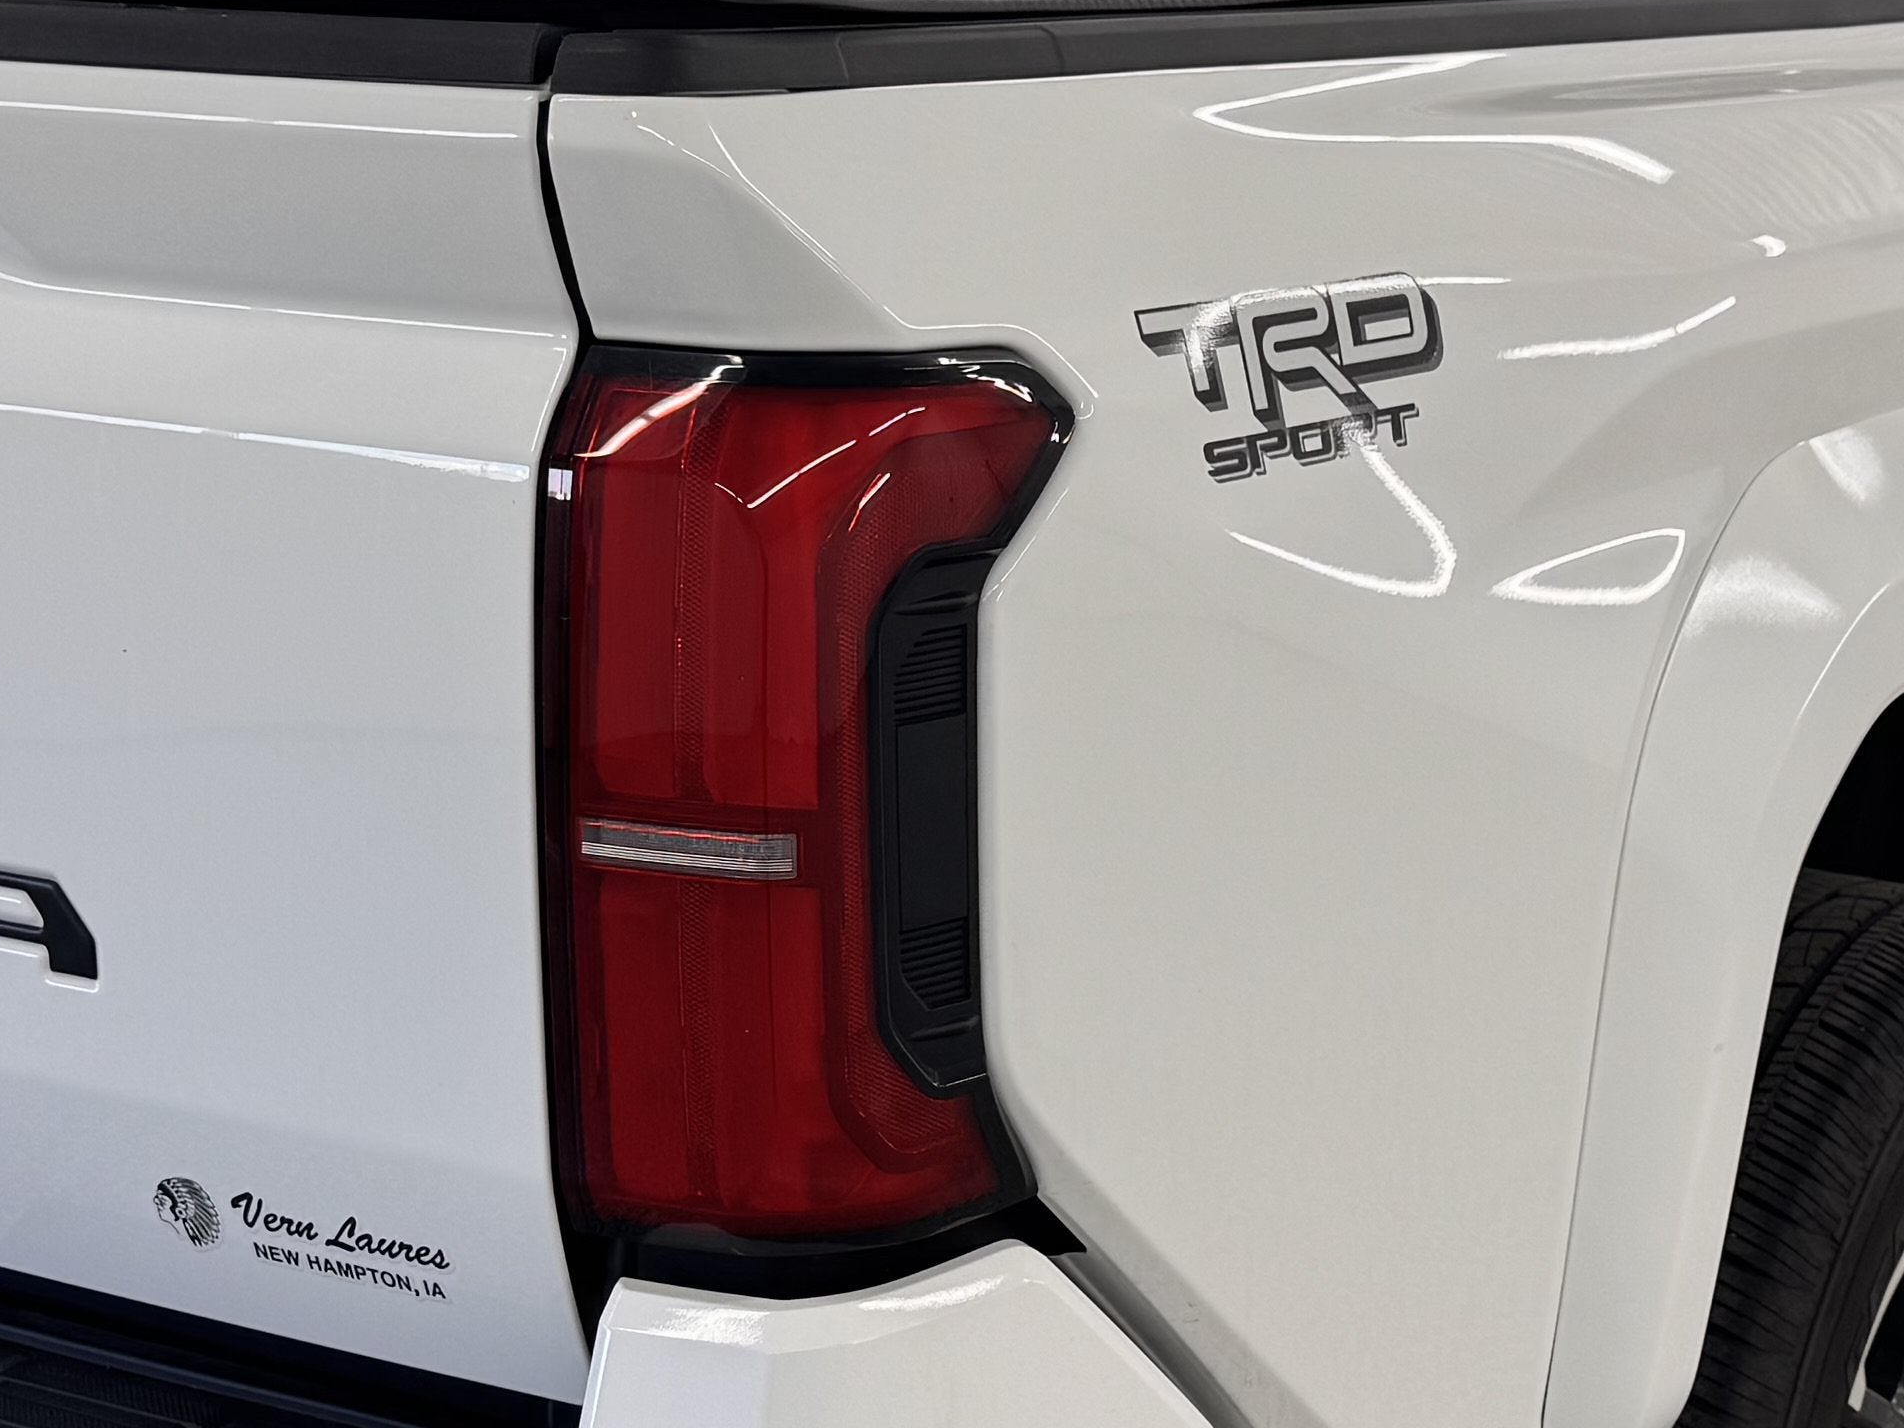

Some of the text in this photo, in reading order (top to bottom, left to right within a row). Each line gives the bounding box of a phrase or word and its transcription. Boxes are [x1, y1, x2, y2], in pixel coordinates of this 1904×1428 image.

[1133, 271, 1444, 432] TRD
[230, 1191, 450, 1270] Vern Laures
[253, 1241, 446, 1299] NEW HAMPTON, IA
